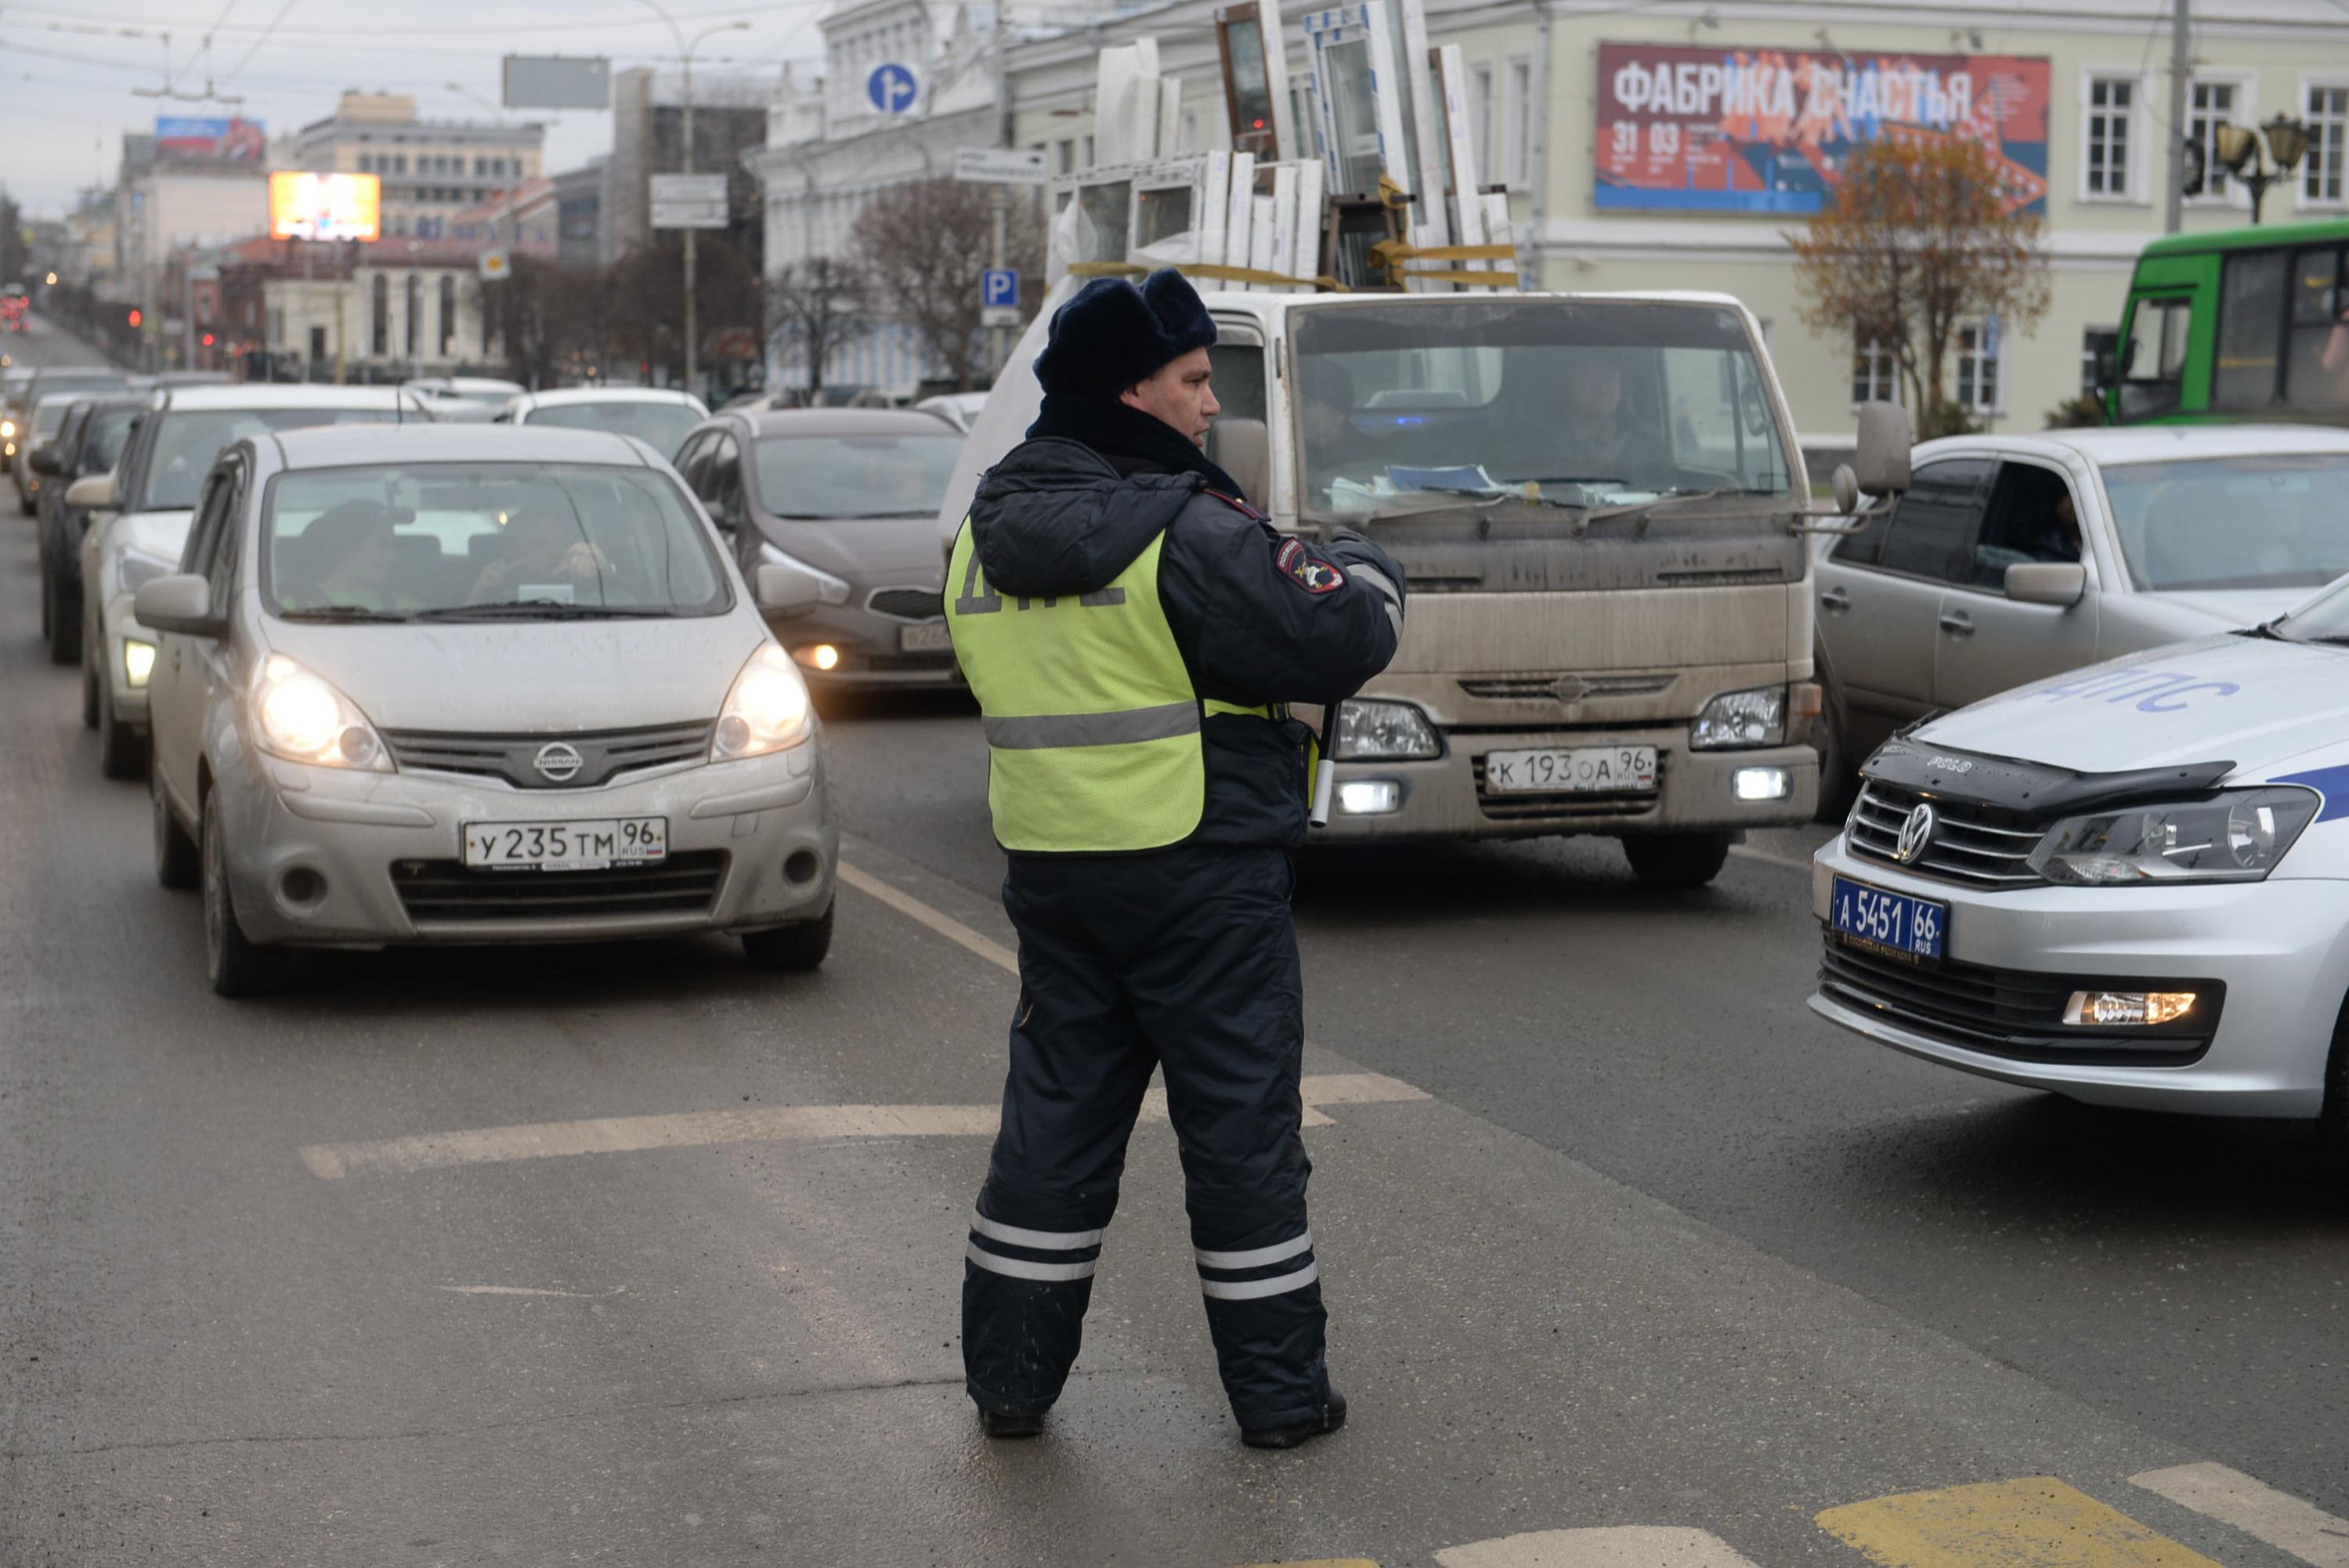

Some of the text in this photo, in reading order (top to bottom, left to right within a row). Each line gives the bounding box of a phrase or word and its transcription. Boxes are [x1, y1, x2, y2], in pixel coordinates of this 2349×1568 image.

[1614, 61, 1795, 118] ФАБРИКА
[1811, 67, 1972, 122] СЧАСТЬЯ
[1612, 121, 1639, 154] 31
[2015, 668, 2241, 712] ДПС
[1621, 750, 1646, 771] 96
[1927, 757, 1972, 773] POLO
[623, 822, 655, 845] 96
[622, 846, 645, 855] RUS
[1914, 904, 1935, 941] 66
[1915, 939, 1932, 955] RUS
